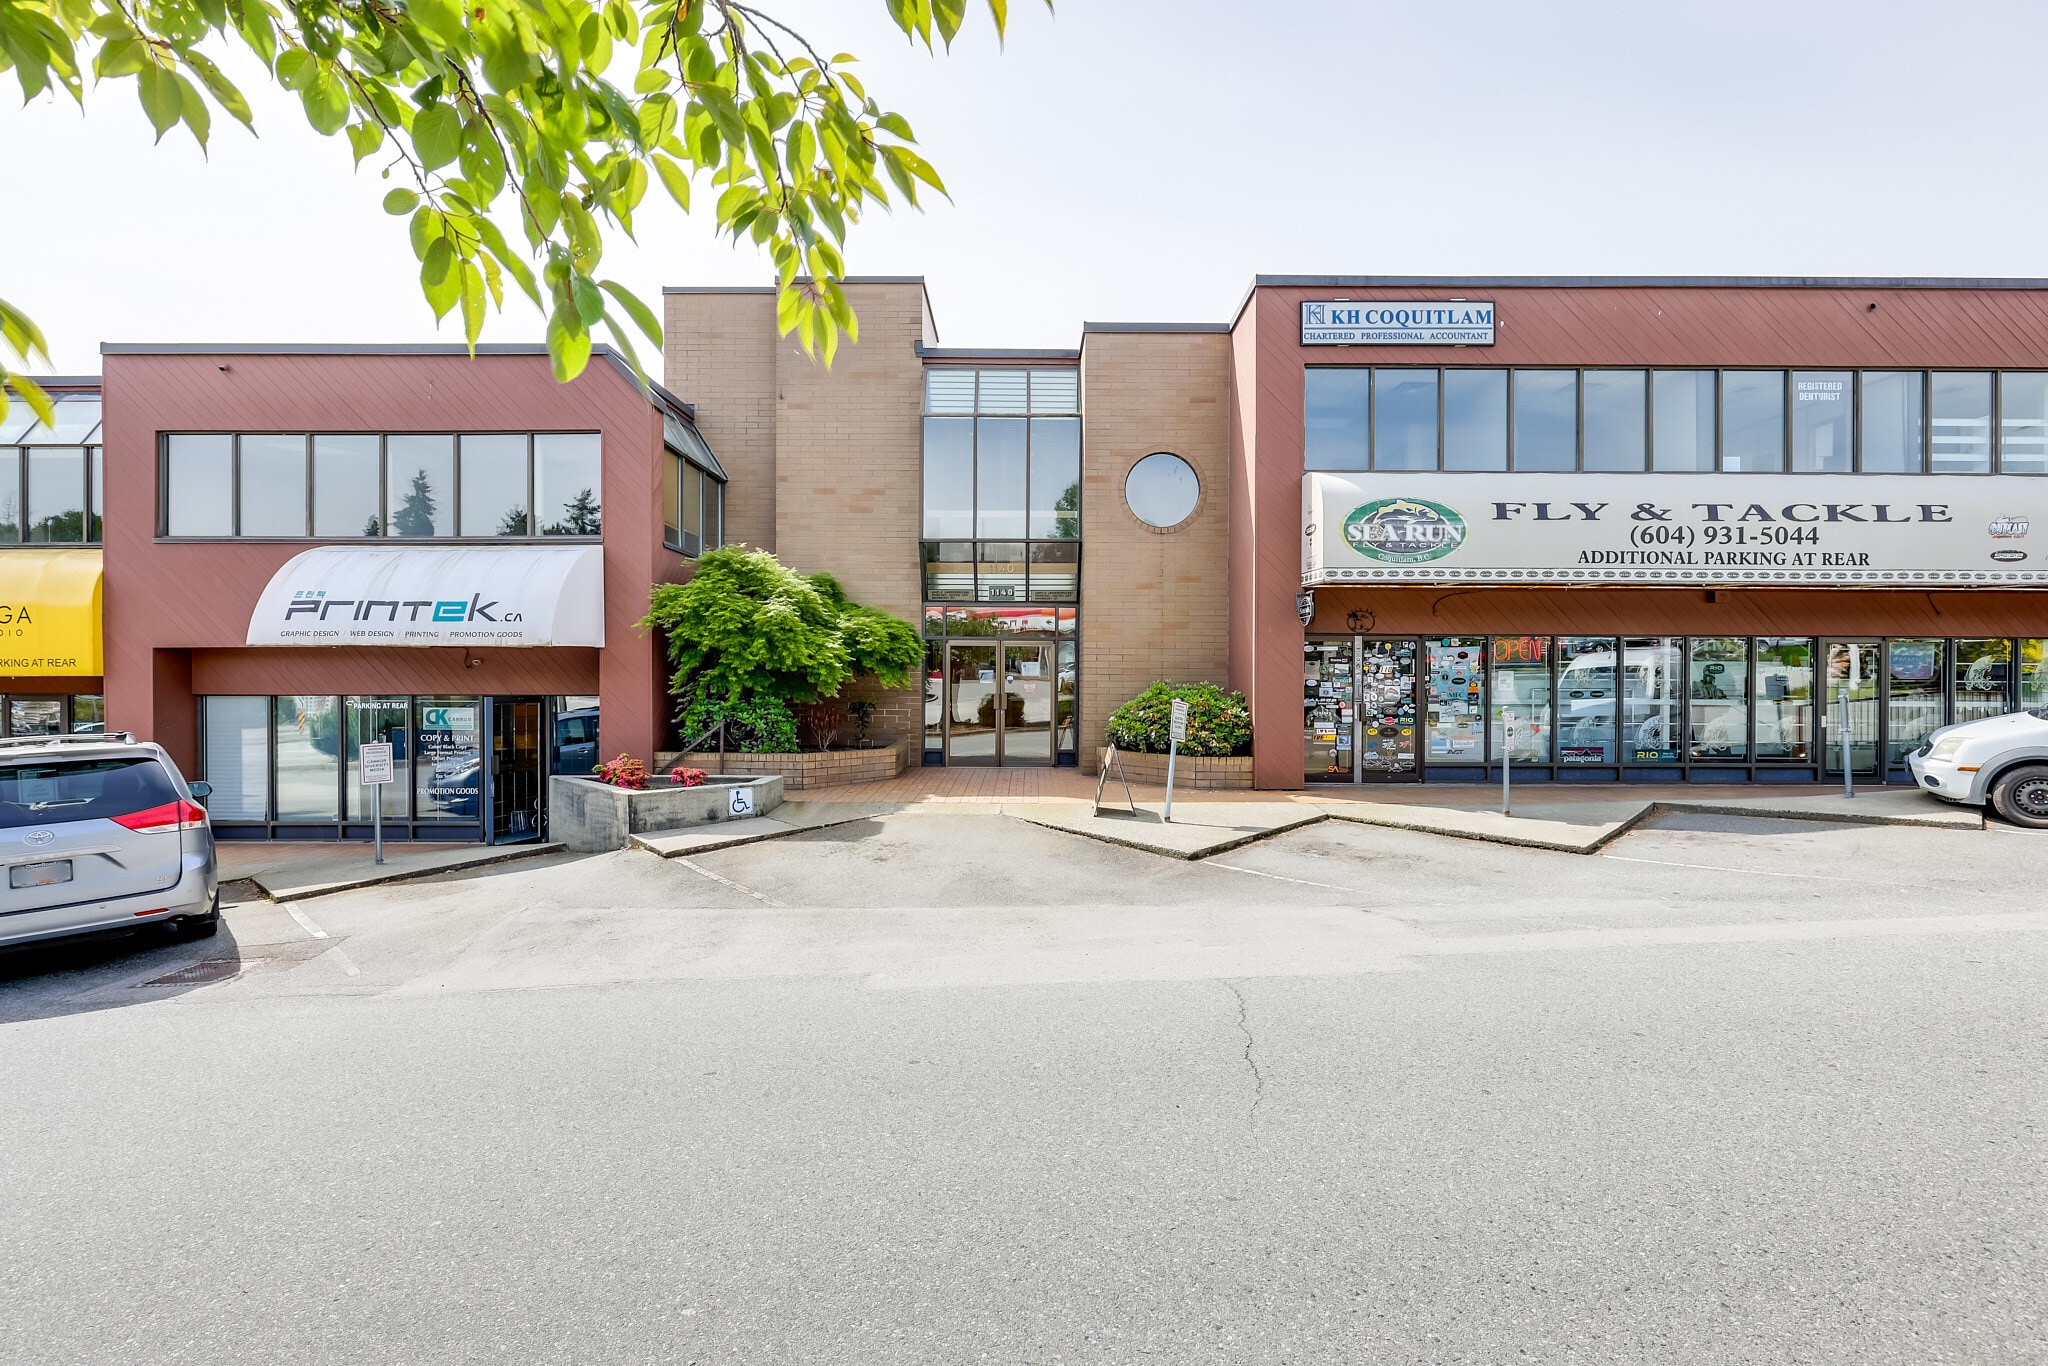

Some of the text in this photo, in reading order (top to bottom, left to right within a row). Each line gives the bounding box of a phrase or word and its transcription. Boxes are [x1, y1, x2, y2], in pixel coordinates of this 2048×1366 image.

[1331, 309, 1492, 327] KH COQUITLAM
[1304, 332, 1488, 340] CHARTERED PROFESSIONAL ACCOUNTANT
[1798, 382, 1842, 390] REGISTERED
[1799, 392, 1840, 400] DENTURIST
[1492, 502, 1953, 522] FLY & TACKLE
[1630, 525, 1819, 548] (604) 931-5044
[1578, 551, 1870, 566] ADDITIONAL PARKING AT REAR
[990, 588, 1013, 596] 1140
[1494, 639, 1541, 660] OPEN
[31, 659, 44, 667] AT
[48, 659, 76, 667] REAR
[420, 734, 442, 742] COPY
[443, 734, 450, 742] &
[1563, 754, 1602, 763] patagonia
[1637, 751, 1659, 759] RIO
